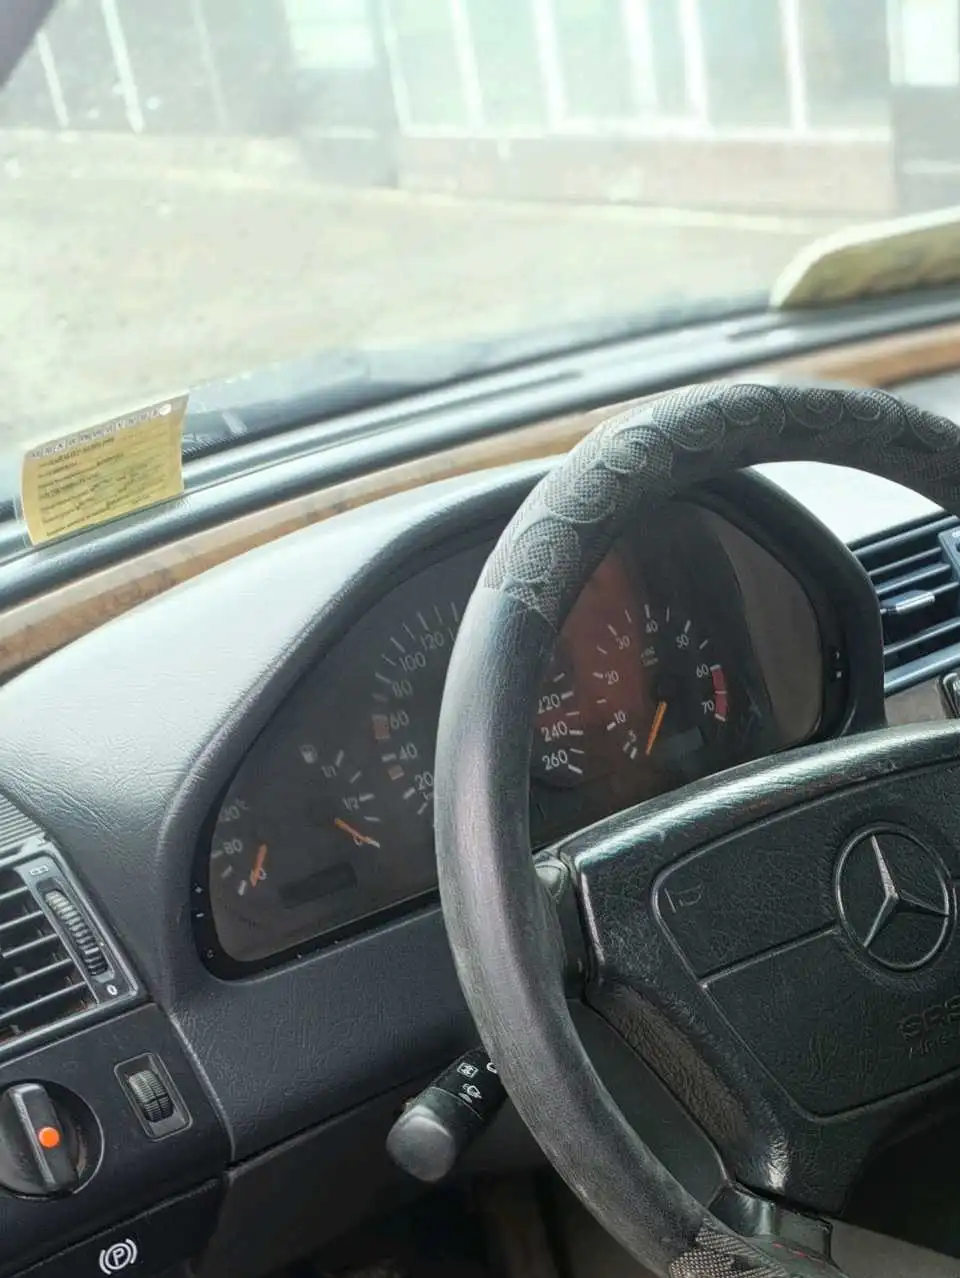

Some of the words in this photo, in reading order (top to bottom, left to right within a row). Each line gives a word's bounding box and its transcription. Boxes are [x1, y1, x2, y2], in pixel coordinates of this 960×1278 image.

[645, 619, 659, 634] 40
[420, 631, 444, 651] 120
[615, 634, 631, 650] 30
[676, 634, 690, 649] 50
[399, 651, 427, 673] 100
[696, 663, 710, 679] 60
[605, 669, 620, 686] 20
[701, 699, 716, 715] 70
[389, 709, 410, 731] 60
[613, 709, 627, 725] 10
[541, 719, 569, 742] 240
[399, 742, 419, 761] 40
[542, 749, 569, 771] 260
[415, 770, 435, 791] 20
[223, 838, 243, 856] 80
